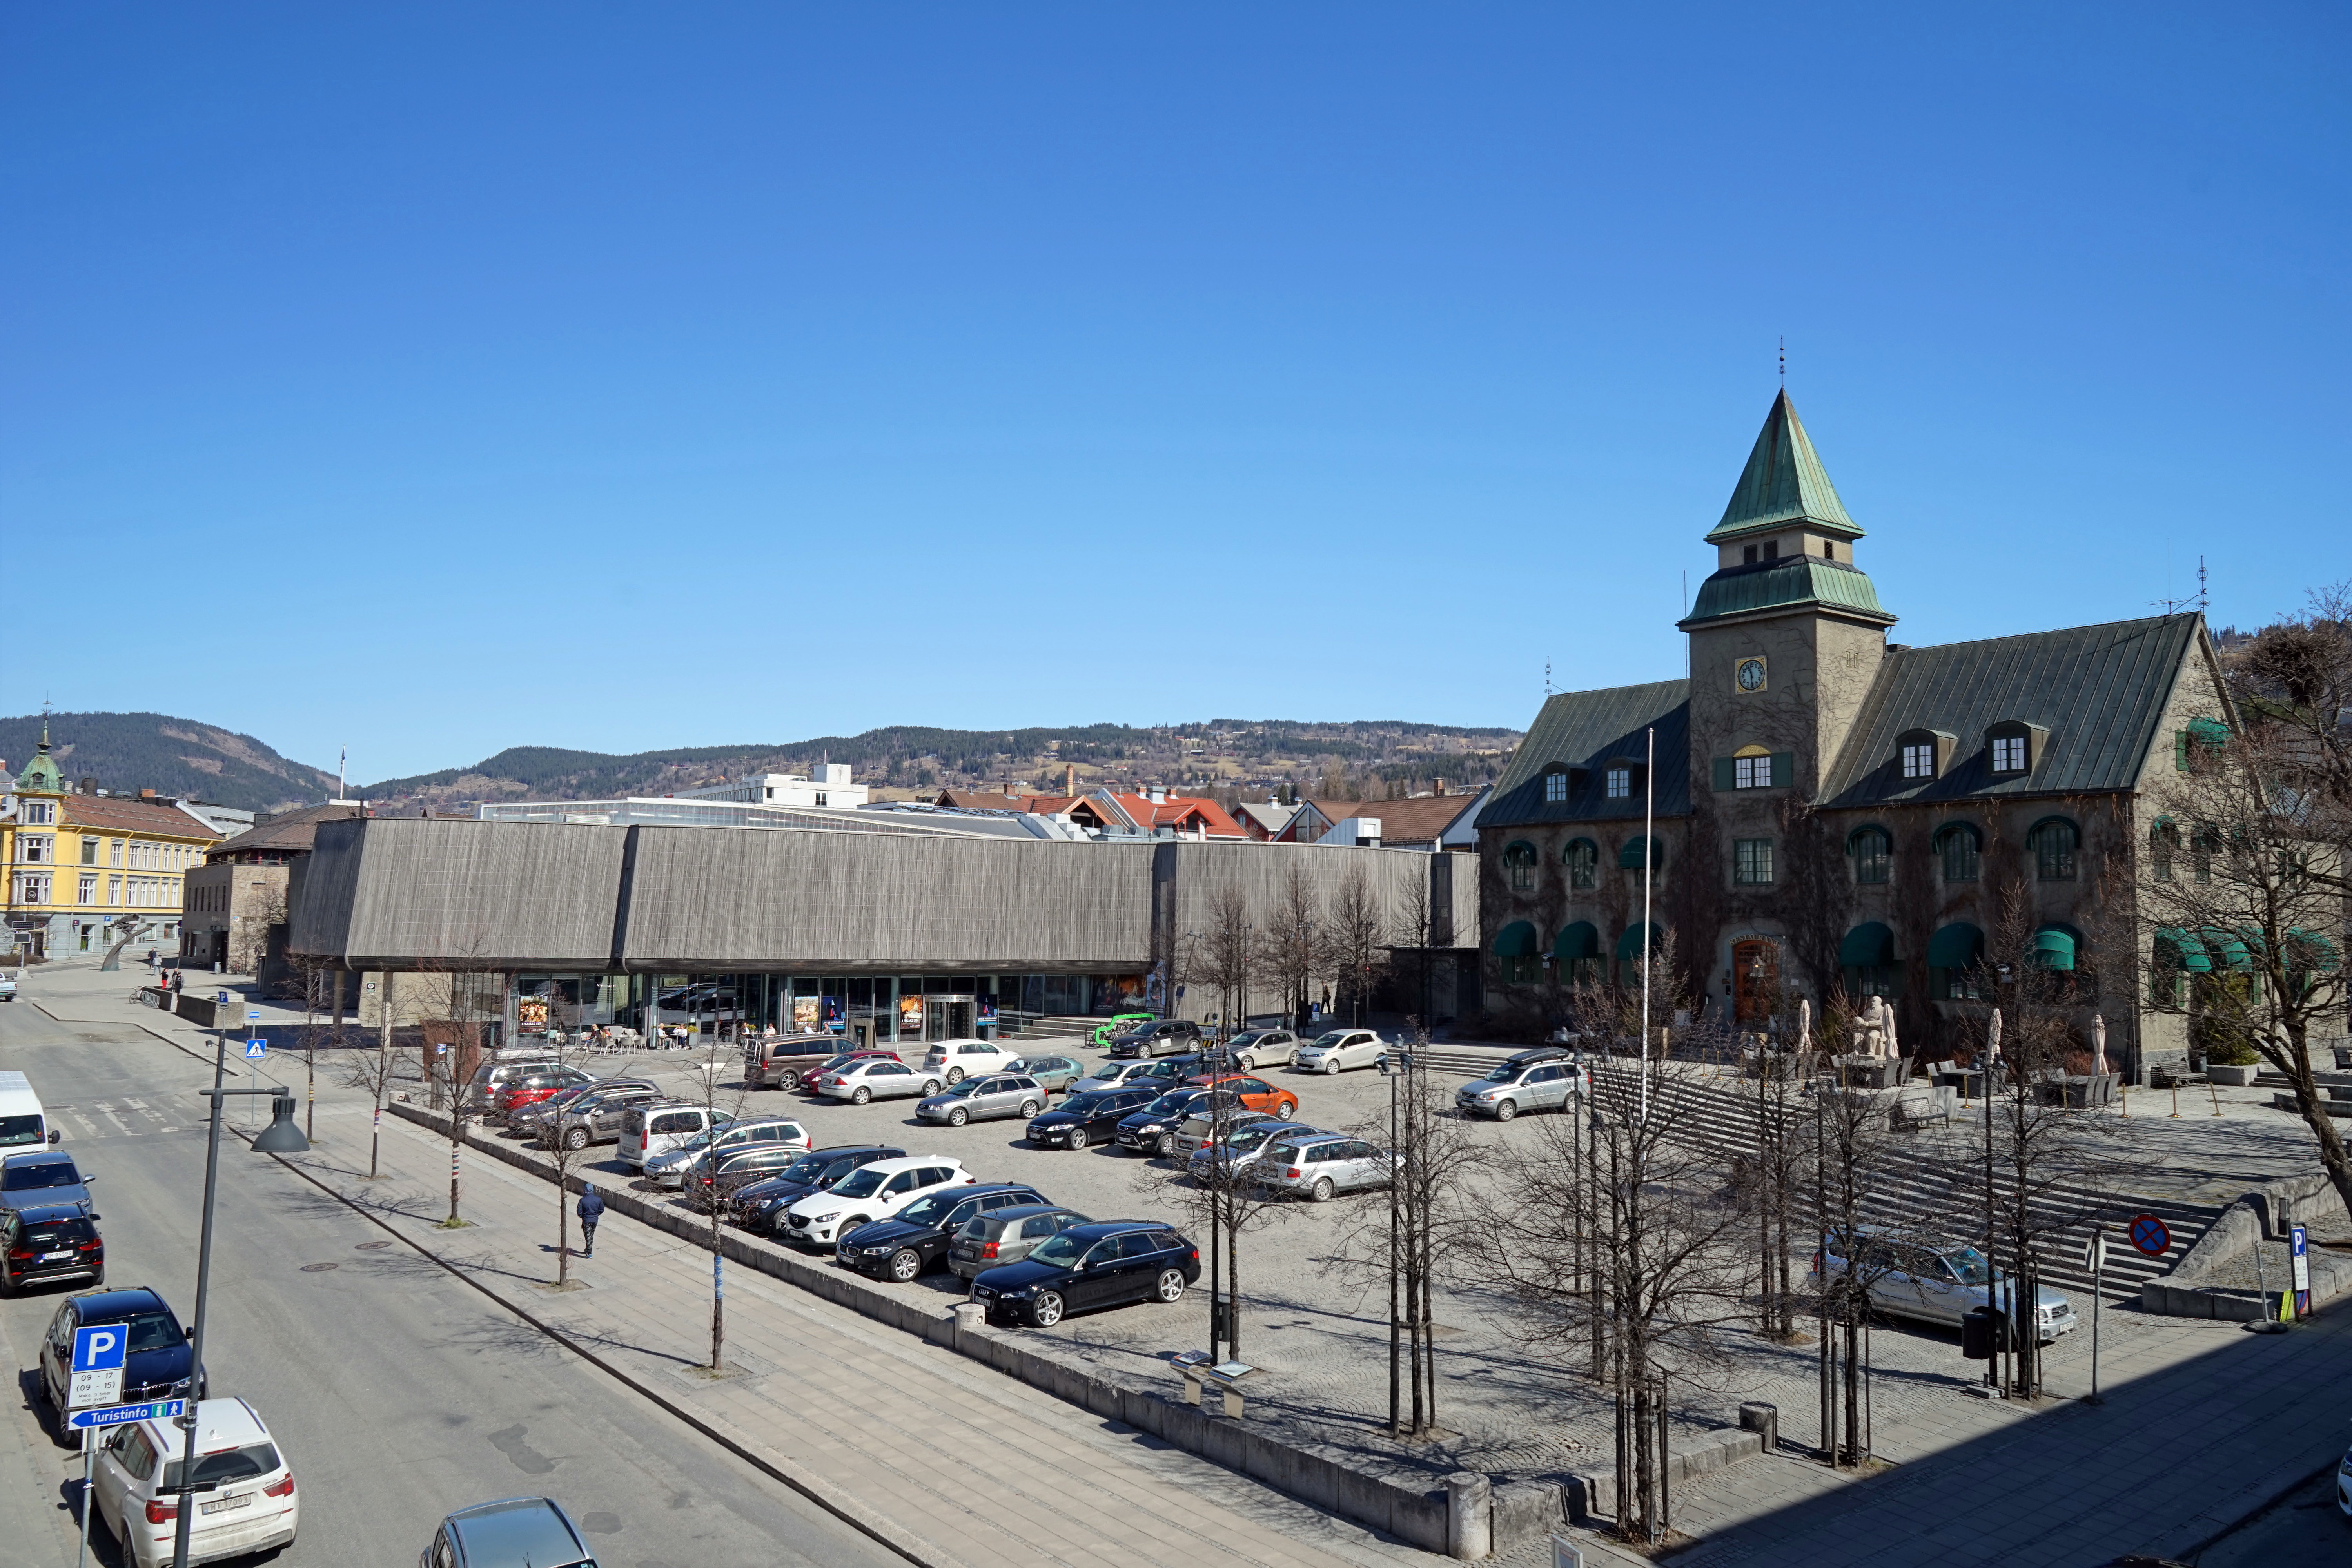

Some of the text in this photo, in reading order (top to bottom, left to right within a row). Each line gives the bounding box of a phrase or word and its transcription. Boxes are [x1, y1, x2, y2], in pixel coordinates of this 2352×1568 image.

[221, 993, 226, 1001] P
[2294, 1232, 2302, 1253] P
[87, 1332, 115, 1366] P
[91, 1407, 148, 1423] Turistinfo
[211, 1496, 248, 1511] HT 17093
